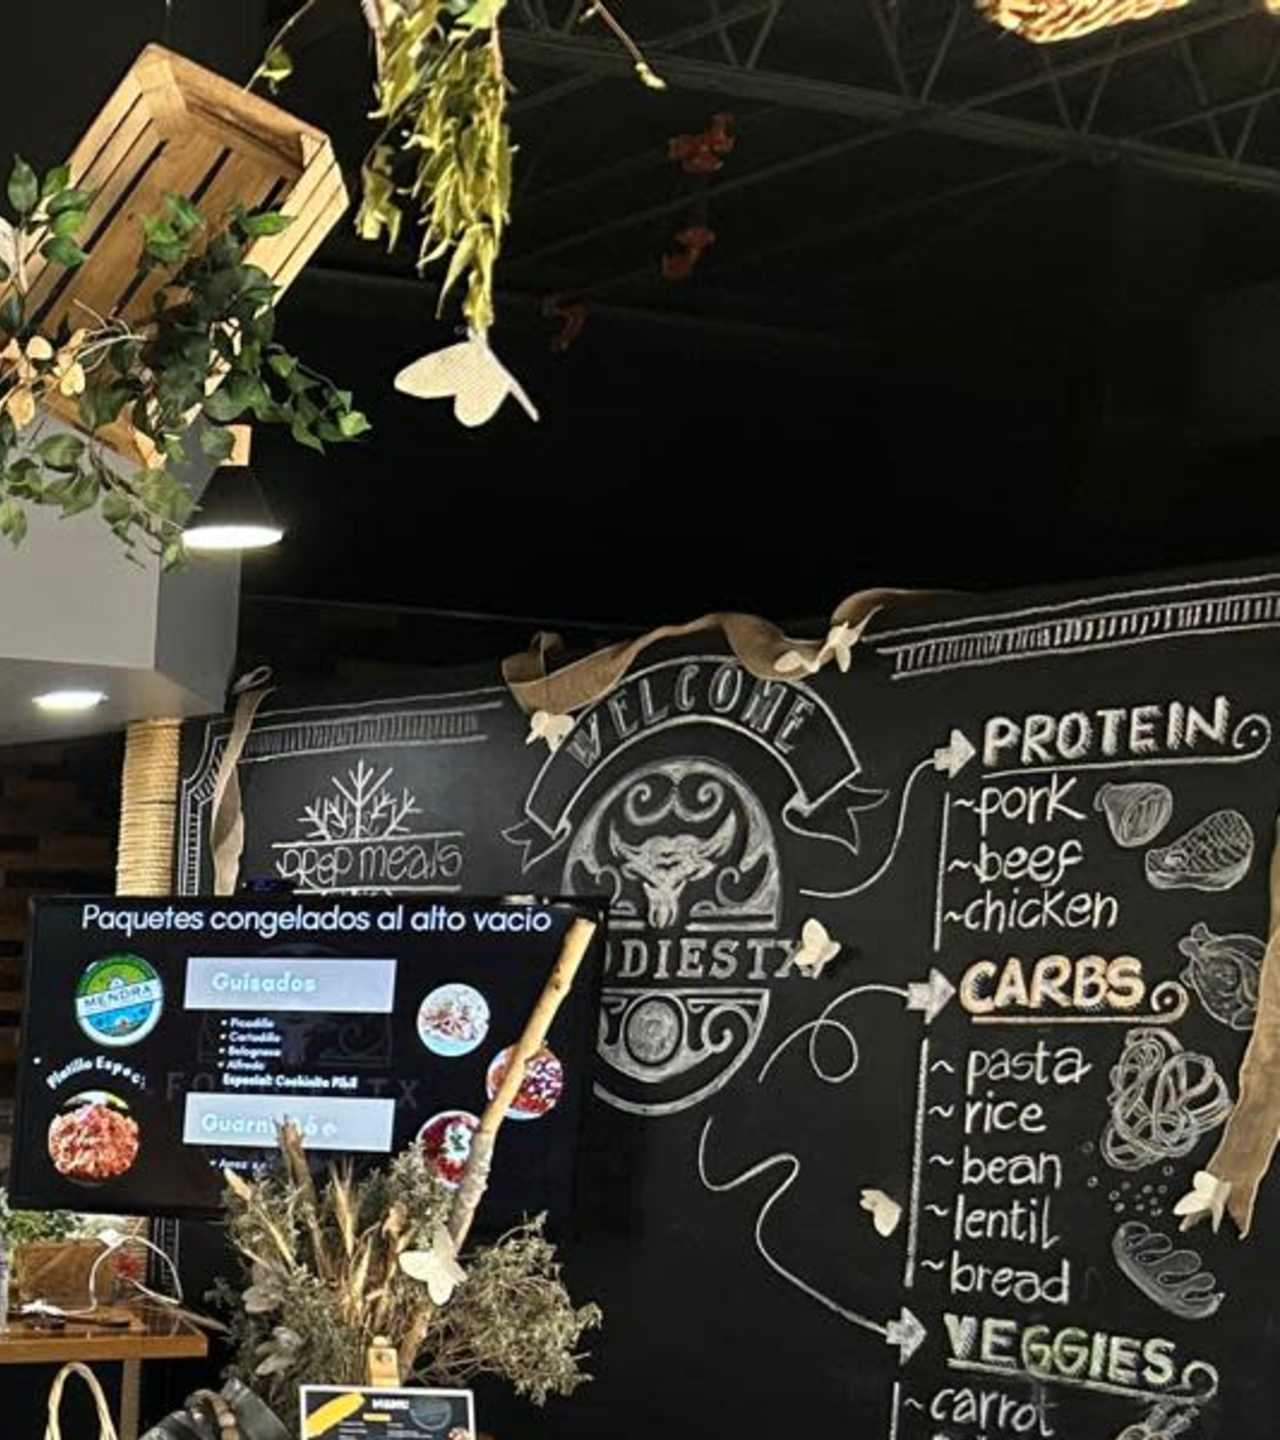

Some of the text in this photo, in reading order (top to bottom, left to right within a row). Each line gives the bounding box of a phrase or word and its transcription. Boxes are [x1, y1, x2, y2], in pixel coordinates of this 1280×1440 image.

[565, 664, 816, 769] WELCOME
[982, 696, 1230, 768] PROTEIN
[973, 774, 1087, 836] pork
[359, 839, 466, 882] meals
[974, 840, 1086, 888] beef
[82, 903, 205, 938] Paquetes
[209, 903, 371, 938] congelados
[377, 904, 403, 932] al
[410, 904, 467, 932] alto
[964, 889, 1119, 933] chicken
[211, 970, 318, 993] Guisados
[960, 954, 1146, 1017] CARBS
[966, 1041, 1092, 1095] pasta
[964, 1096, 1047, 1135] rice
[961, 1146, 1062, 1189] bean
[954, 1193, 1061, 1249] lentil
[949, 1251, 1071, 1305] bread
[943, 1313, 1178, 1386] VEGGIES
[930, 1387, 1056, 1437] carrot
